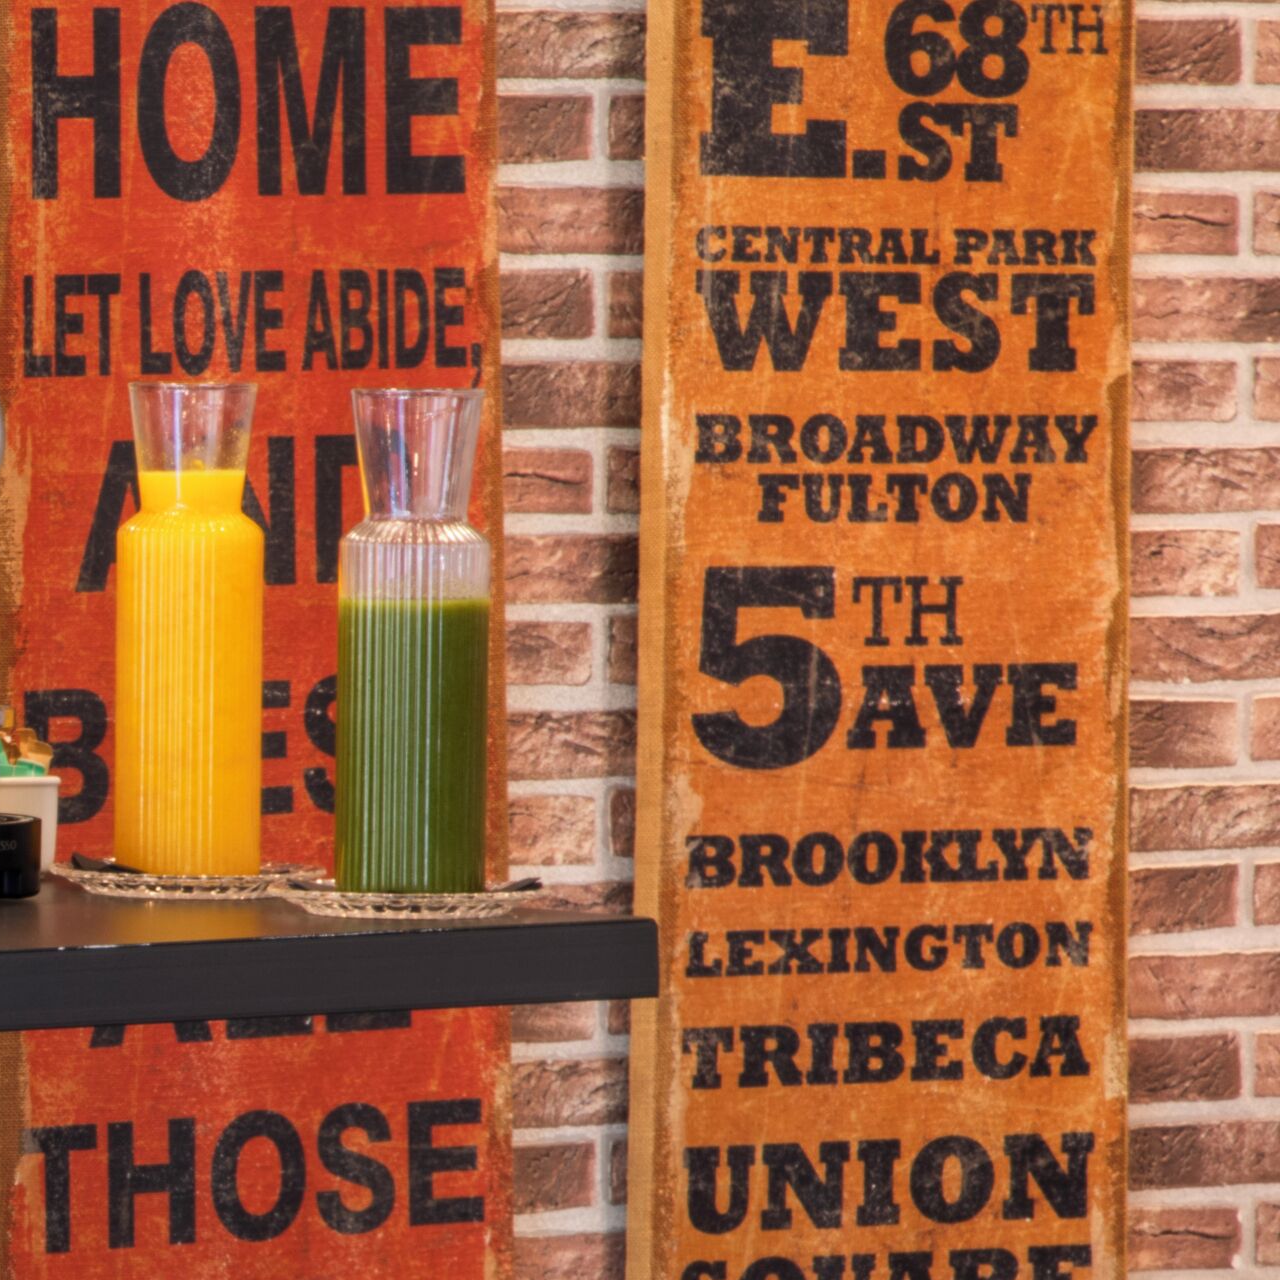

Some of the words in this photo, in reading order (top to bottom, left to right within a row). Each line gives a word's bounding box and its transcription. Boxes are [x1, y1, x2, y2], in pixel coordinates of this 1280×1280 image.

[31, 1, 466, 202] HOME
[898, 101, 1018, 182] ST
[695, 225, 940, 265] CENTRAL
[953, 228, 1097, 266] PARK
[22, 273, 121, 378] LET
[139, 270, 287, 376] LOVE
[695, 269, 1096, 373] WEST
[695, 413, 1098, 464] BROADWAY
[757, 473, 1032, 523] FULTON
[847, 661, 1078, 750] AVE
[685, 827, 1094, 888] BROOKLYN
[685, 920, 1093, 978] LEXINGTON
[682, 1014, 1091, 1090] TRIBECA
[23, 1098, 486, 1255] THOSE
[683, 1132, 1095, 1235] UNION
